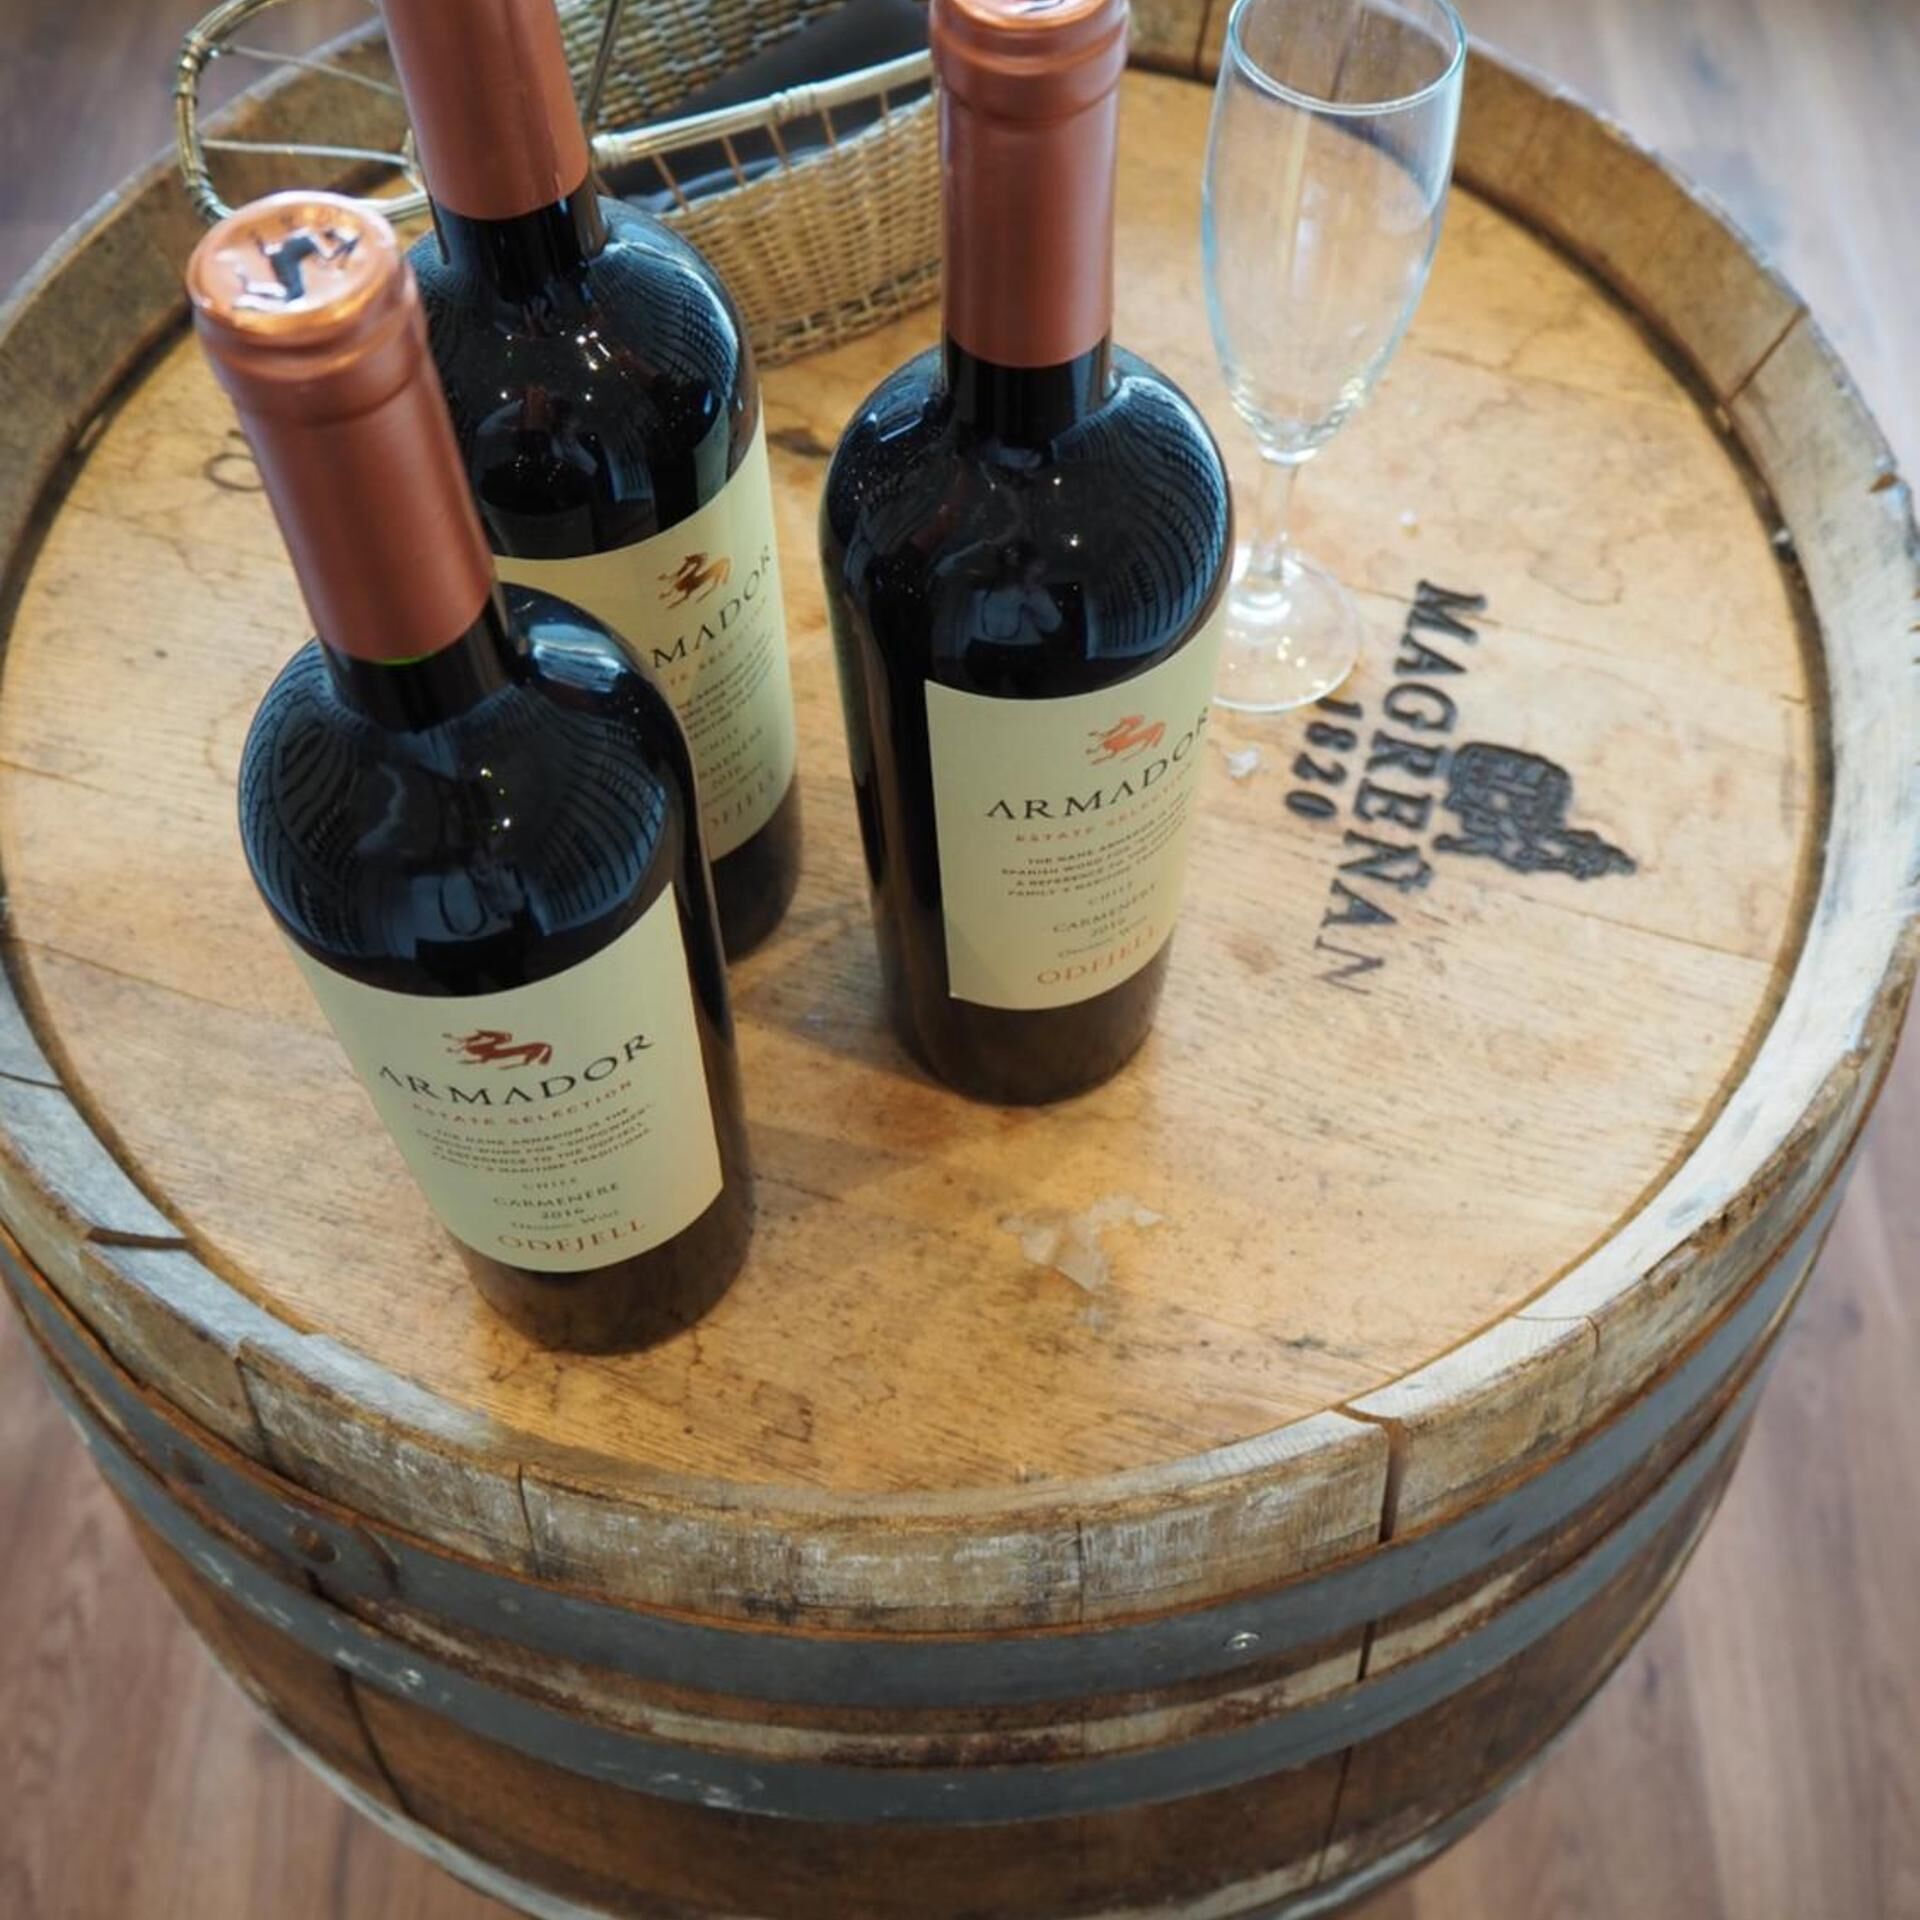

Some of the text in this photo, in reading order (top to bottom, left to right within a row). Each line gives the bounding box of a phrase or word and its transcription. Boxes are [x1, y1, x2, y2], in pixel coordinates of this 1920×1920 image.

[651, 545, 771, 669] MADOR
[1283, 695, 1363, 821] 1820
[378, 1033, 654, 1106] ARMADOR
[507, 1080, 633, 1126] SELECTION
[496, 1218, 647, 1252] ODFJELL
